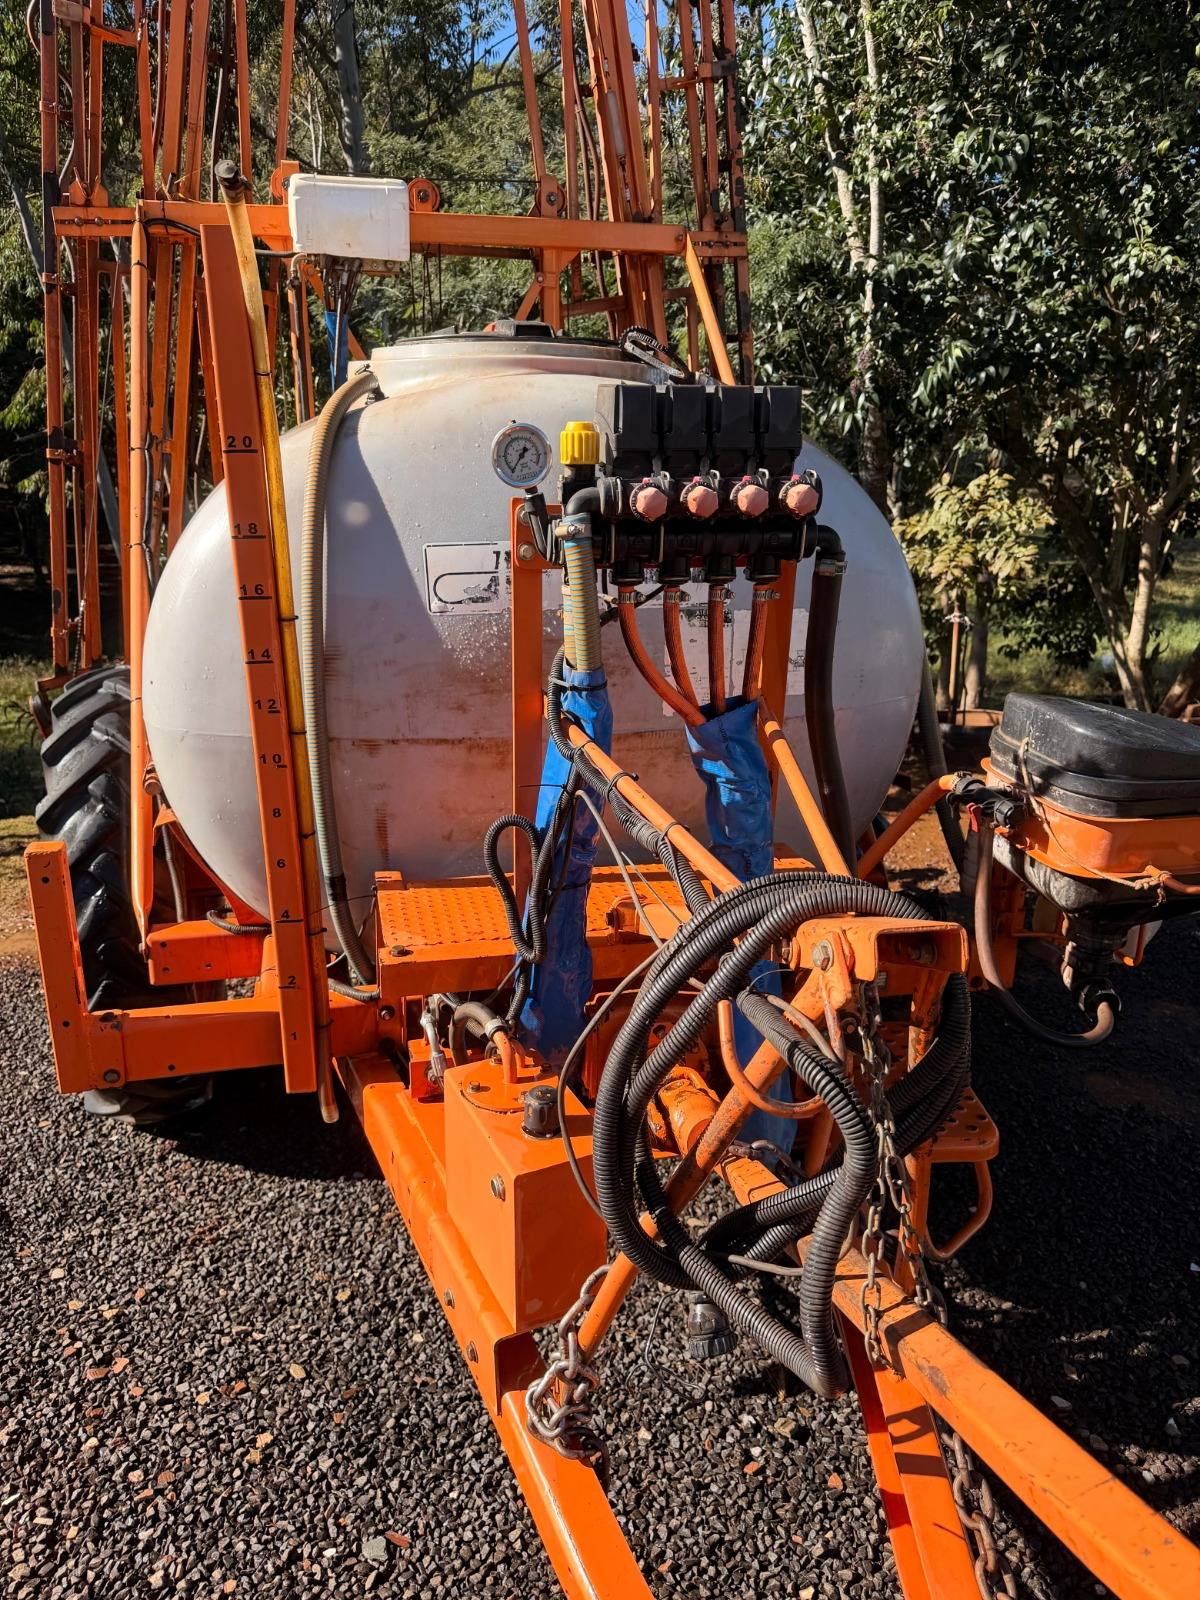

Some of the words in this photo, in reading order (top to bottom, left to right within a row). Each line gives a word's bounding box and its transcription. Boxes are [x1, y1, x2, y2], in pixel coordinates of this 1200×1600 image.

[226, 435, 252, 448] 20
[234, 522, 257, 535] 18
[240, 584, 264, 596] 16
[247, 649, 271, 660] 14
[255, 698, 276, 710] 12
[259, 753, 281, 765] 10
[272, 807, 282, 818] 8
[276, 858, 286, 868] 6
[281, 909, 290, 920] 4
[287, 975, 297, 986] 2
[291, 1031, 297, 1041] 1
